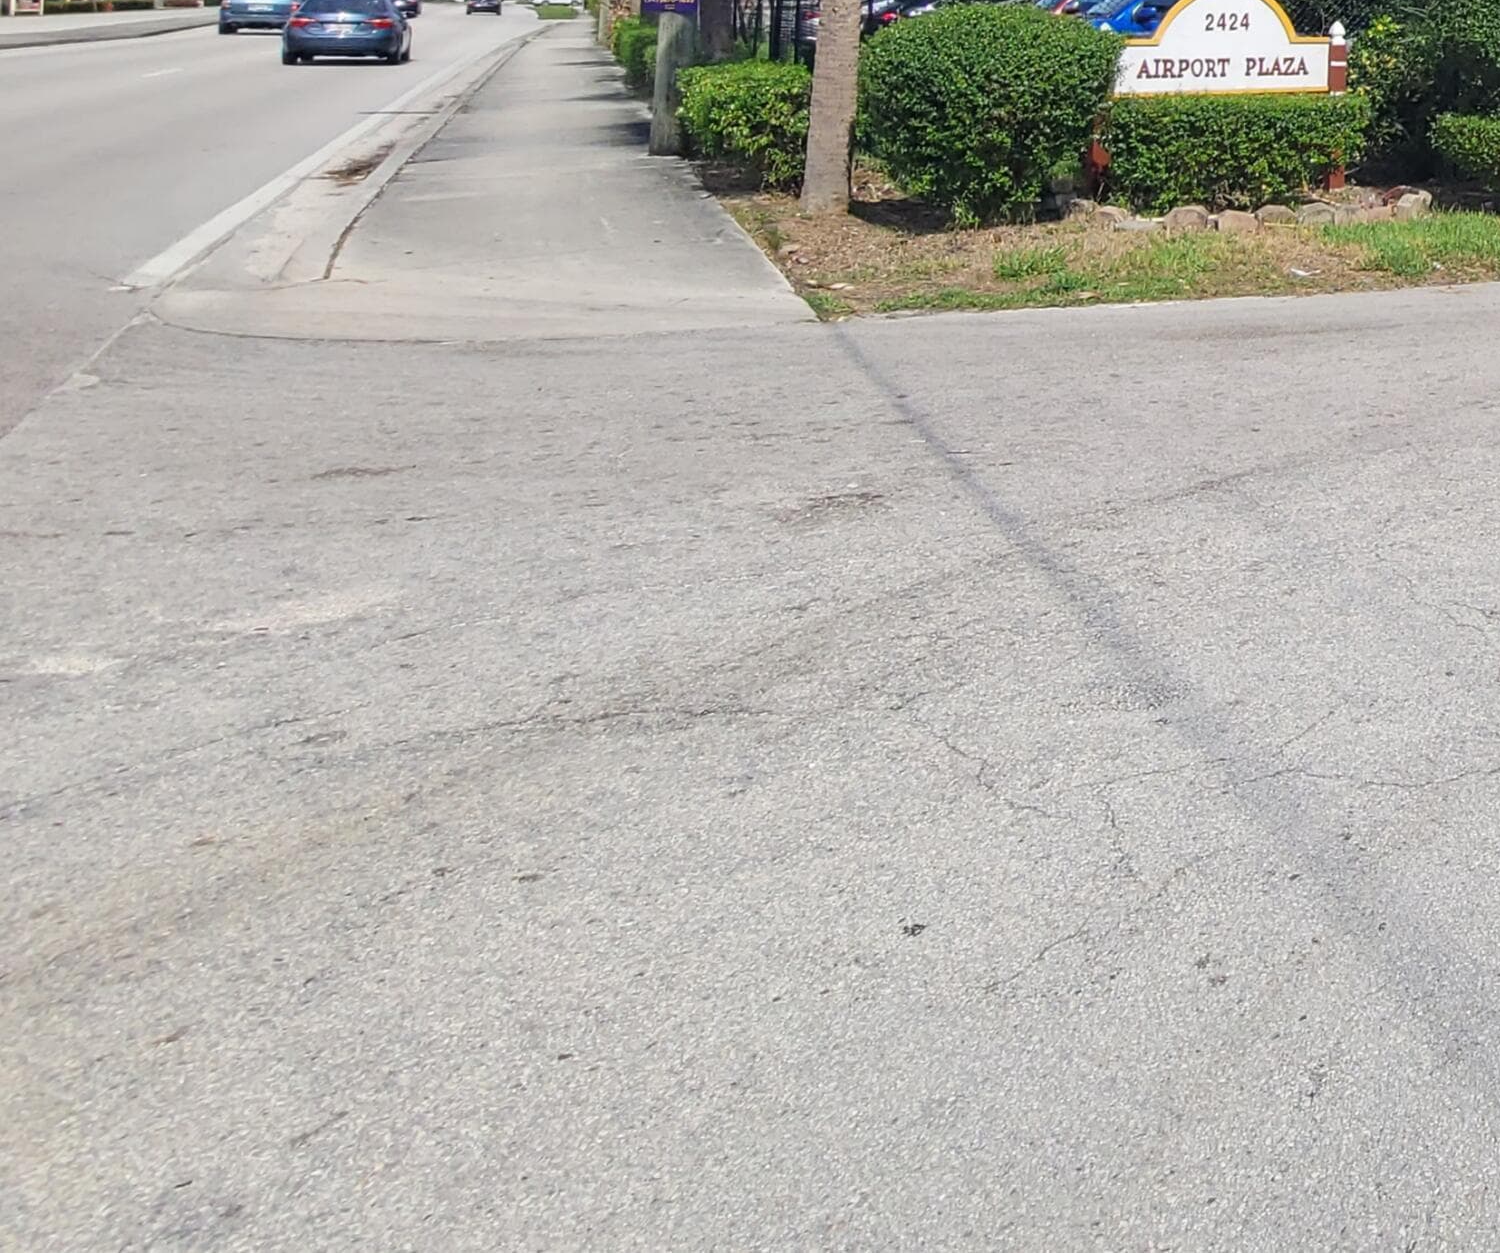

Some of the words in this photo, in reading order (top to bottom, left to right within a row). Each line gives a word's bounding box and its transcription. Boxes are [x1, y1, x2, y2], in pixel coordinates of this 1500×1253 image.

[1205, 12, 1250, 32] 2424
[1136, 57, 1231, 79] AIRPORT
[1244, 56, 1310, 77] PLAZA
